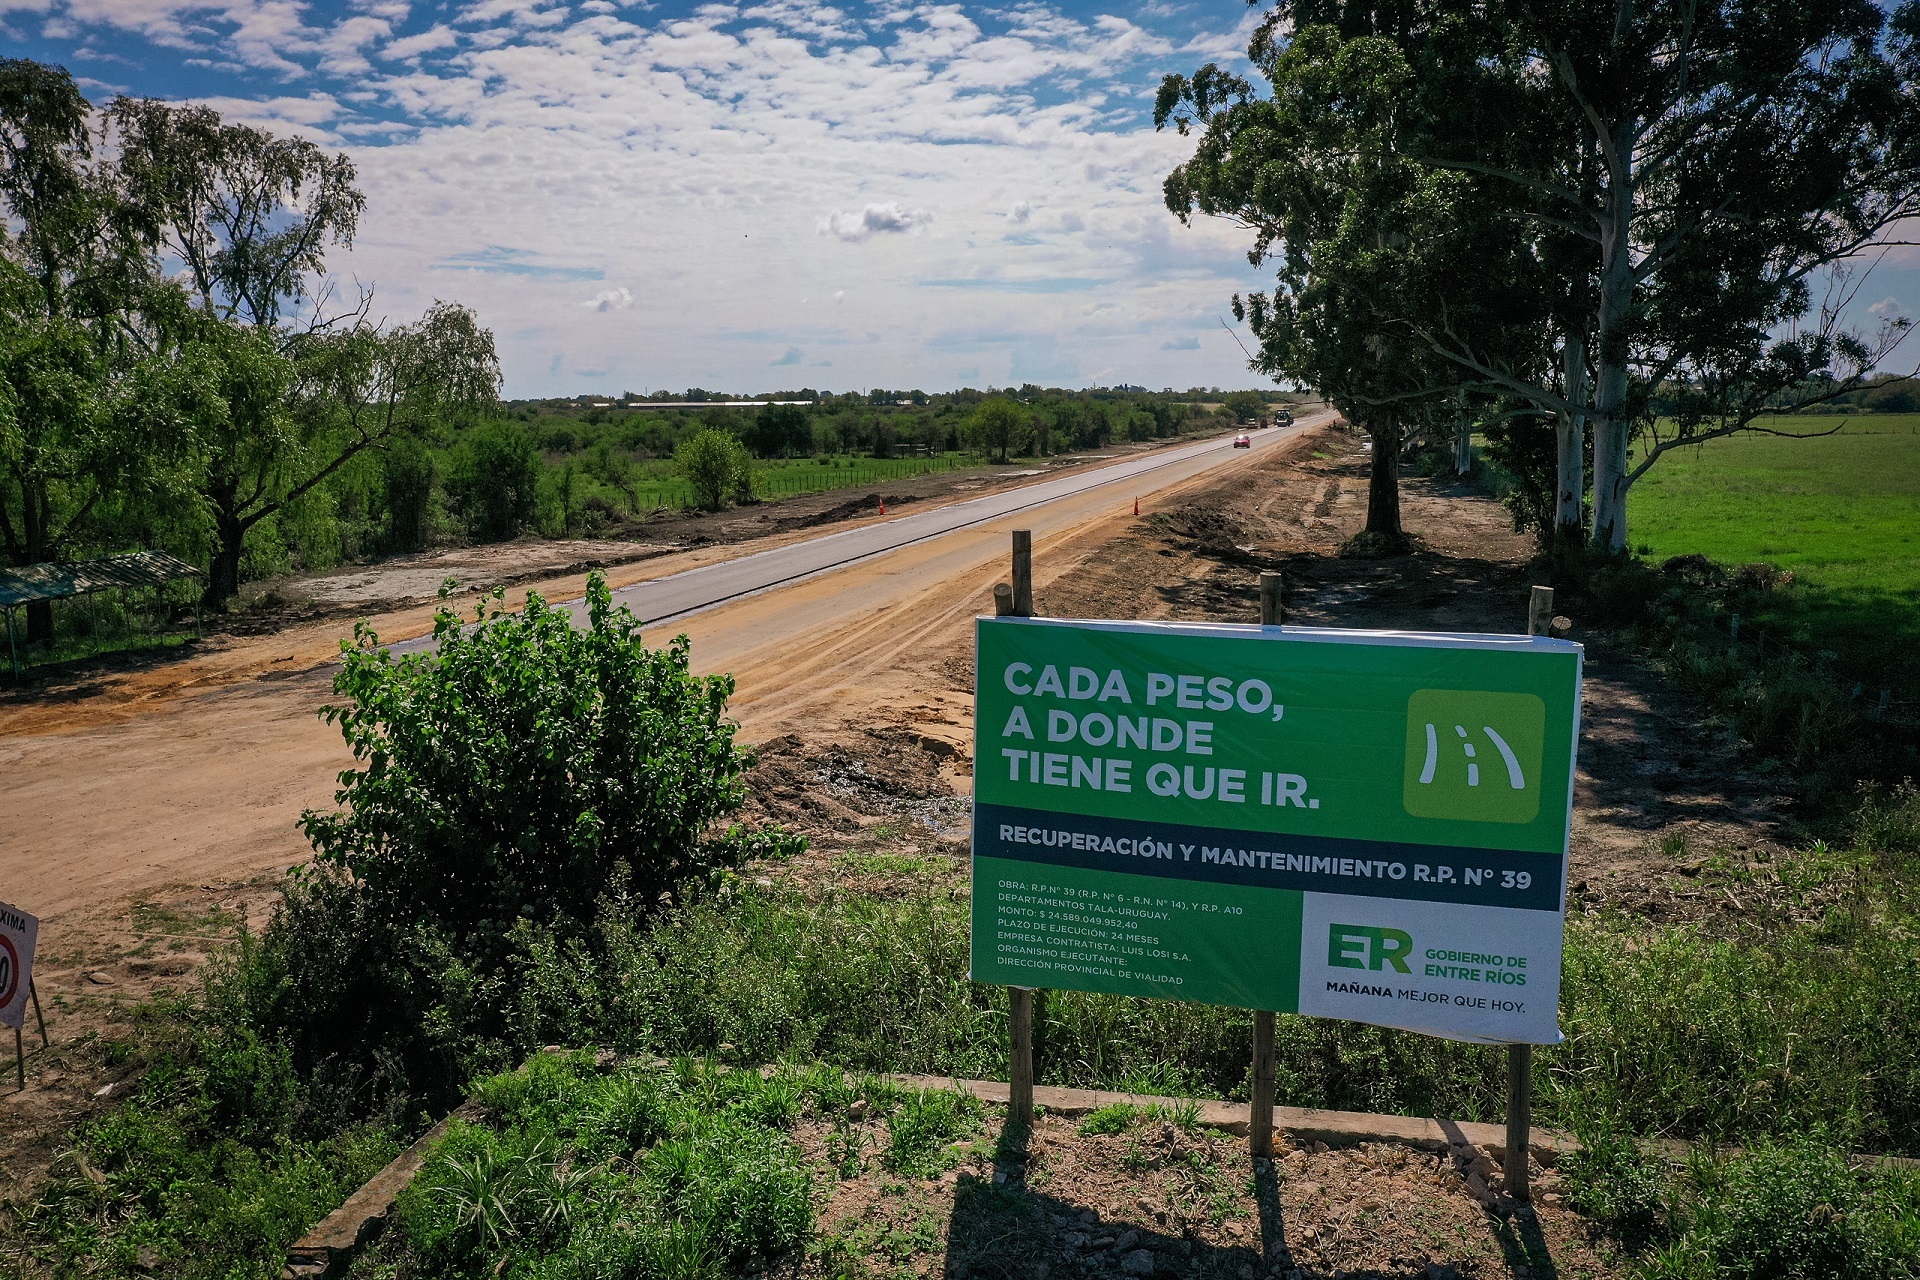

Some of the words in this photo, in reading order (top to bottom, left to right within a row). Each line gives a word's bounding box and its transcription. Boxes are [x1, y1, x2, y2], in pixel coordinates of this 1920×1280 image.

[1003, 662, 1132, 704] CADA
[1146, 672, 1284, 722] PESO,
[1002, 705, 1034, 740] A
[1048, 709, 1214, 755] DONDE
[1001, 748, 1132, 793] TIENE
[1146, 762, 1246, 803] QUE
[1261, 771, 1320, 809] IR.
[999, 824, 1173, 859] RECUPERACIÓN
[1179, 844, 1195, 861] Y
[1201, 846, 1407, 879] MANTENIMIENTO
[1413, 863, 1457, 884] R.P.
[1500, 870, 1532, 890] 39
[998, 880, 1029, 891] OBRA:
[1063, 888, 1075, 896] 39
[1078, 890, 1100, 899] (R.P.
[1133, 896, 1153, 906] R.N.
[1171, 900, 1189, 910] 14),
[1192, 902, 1198, 910] Y
[1201, 903, 1221, 913] R.P.
[1223, 906, 1243, 915] A10
[998, 893, 1085, 910] DEPARTAMENTOS
[1088, 903, 1171, 921] TALA-URUGUAY.
[998, 906, 1037, 916] MONTO:
[1039, 910, 1045, 919] $
[1048, 912, 1138, 929] 24.589.049.952,40
[998, 918, 1031, 929] PLAZO
[1033, 922, 1047, 931] DE
[1049, 924, 1108, 939] EJECUCIÓN:
[1111, 932, 1123, 940] 24
[1126, 933, 1159, 945] MESES
[997, 931, 1043, 943] EMPRESA
[1046, 936, 1119, 952] CONTRATISTA:
[1121, 946, 1144, 956] LUIS
[1146, 949, 1170, 958] LOSI
[1172, 953, 1192, 961] S.A.
[997, 944, 1058, 957] ORGANISMO
[1060, 951, 1128, 966] EJECUTANTE:
[1327, 923, 1413, 974] ER
[1425, 949, 1503, 967] GOBIERNO
[1506, 956, 1527, 968] DE
[997, 957, 1051, 969] DIRECCIÓN
[1054, 962, 1115, 976] PROVINCIAL
[1118, 970, 1131, 979] DE
[1134, 972, 1183, 985] VIALIDAD
[1424, 964, 1481, 982] ENTRE
[1485, 969, 1527, 986] RÍOS
[1326, 981, 1393, 998] MAÑANA
[1398, 989, 1449, 1005] MEJOR
[1454, 995, 1487, 1009] QUE
[1491, 1000, 1526, 1014] HOY.
